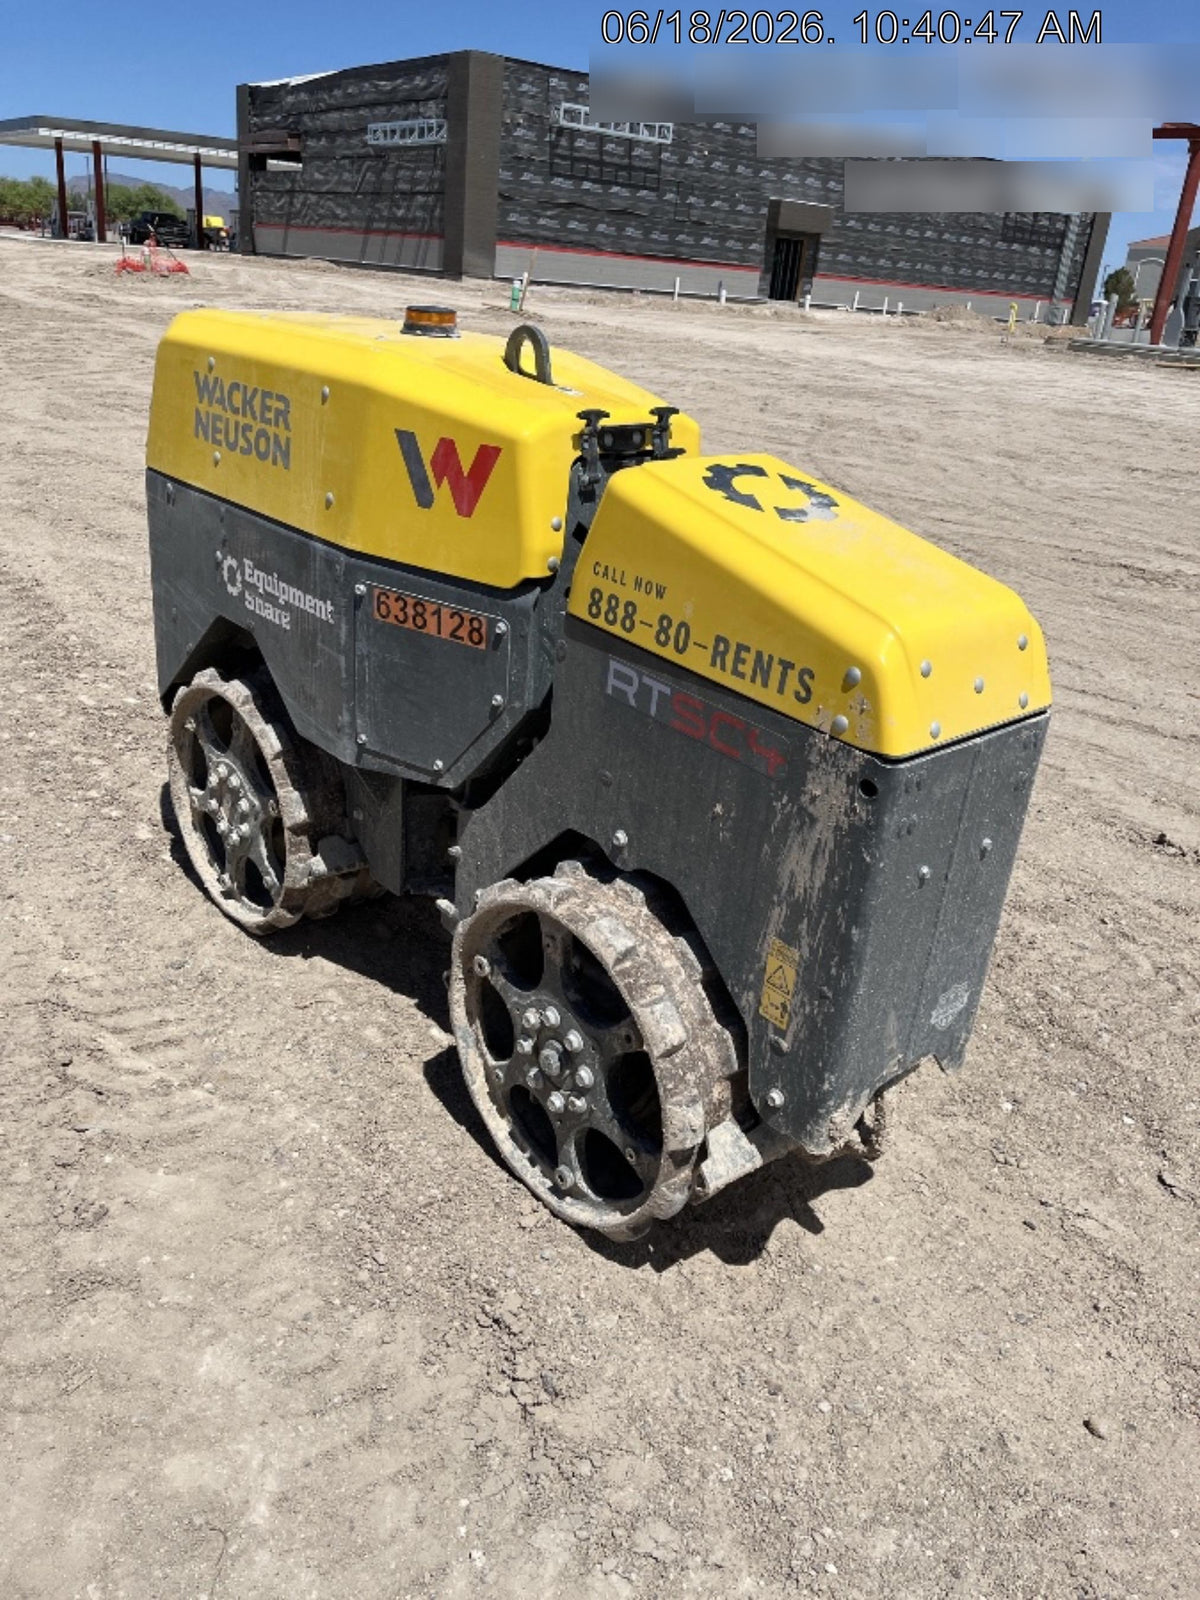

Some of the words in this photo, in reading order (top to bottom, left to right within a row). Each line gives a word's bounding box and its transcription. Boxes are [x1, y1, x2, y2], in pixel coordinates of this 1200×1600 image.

[194, 370, 291, 432] WACKER
[194, 408, 291, 470] NEUSON
[243, 558, 335, 624] Equipment
[593, 561, 626, 586] CALL
[634, 576, 667, 600] NOW
[376, 591, 484, 646] 638128
[587, 587, 816, 704] 888-80-RENTS
